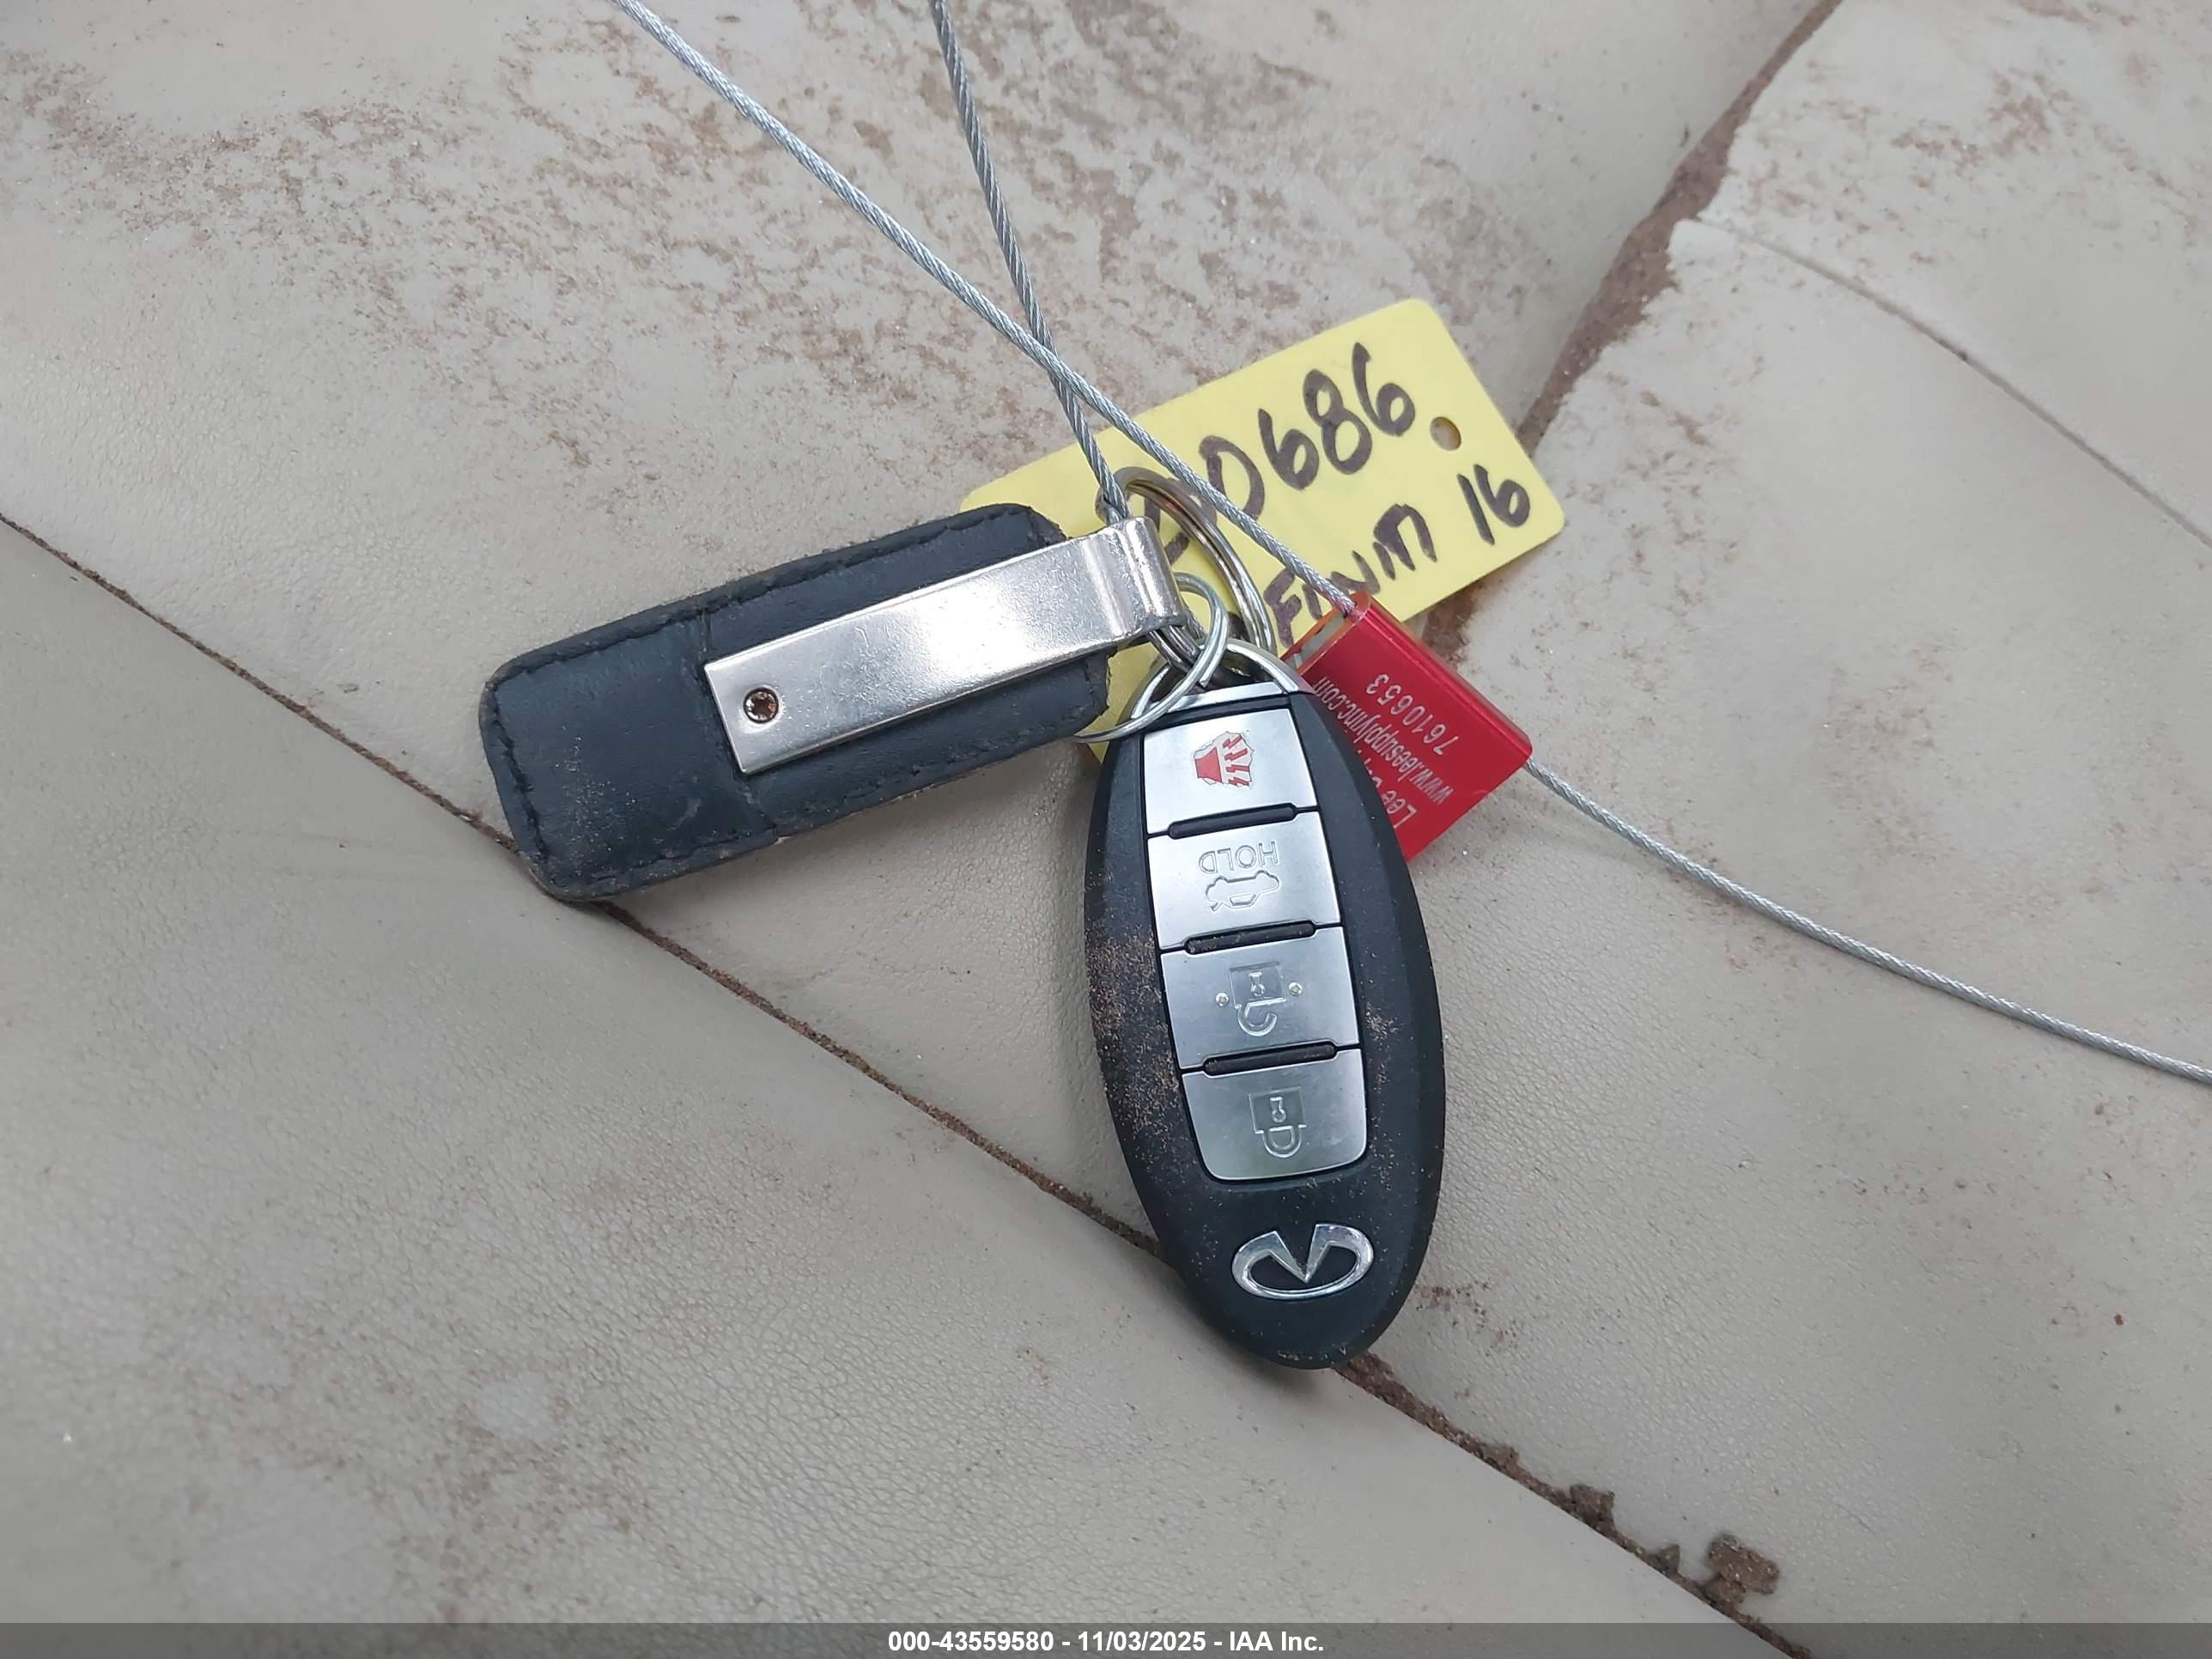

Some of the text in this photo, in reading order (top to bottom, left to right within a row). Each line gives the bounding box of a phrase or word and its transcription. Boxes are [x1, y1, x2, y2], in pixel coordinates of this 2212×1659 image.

[1457, 464, 1531, 545] 16
[1313, 677, 1454, 805] www.leesupplyinc.com
[1365, 673, 1459, 756] 7610653
[1381, 790, 1417, 829] Lee
[1198, 841, 1278, 873] HOLD
